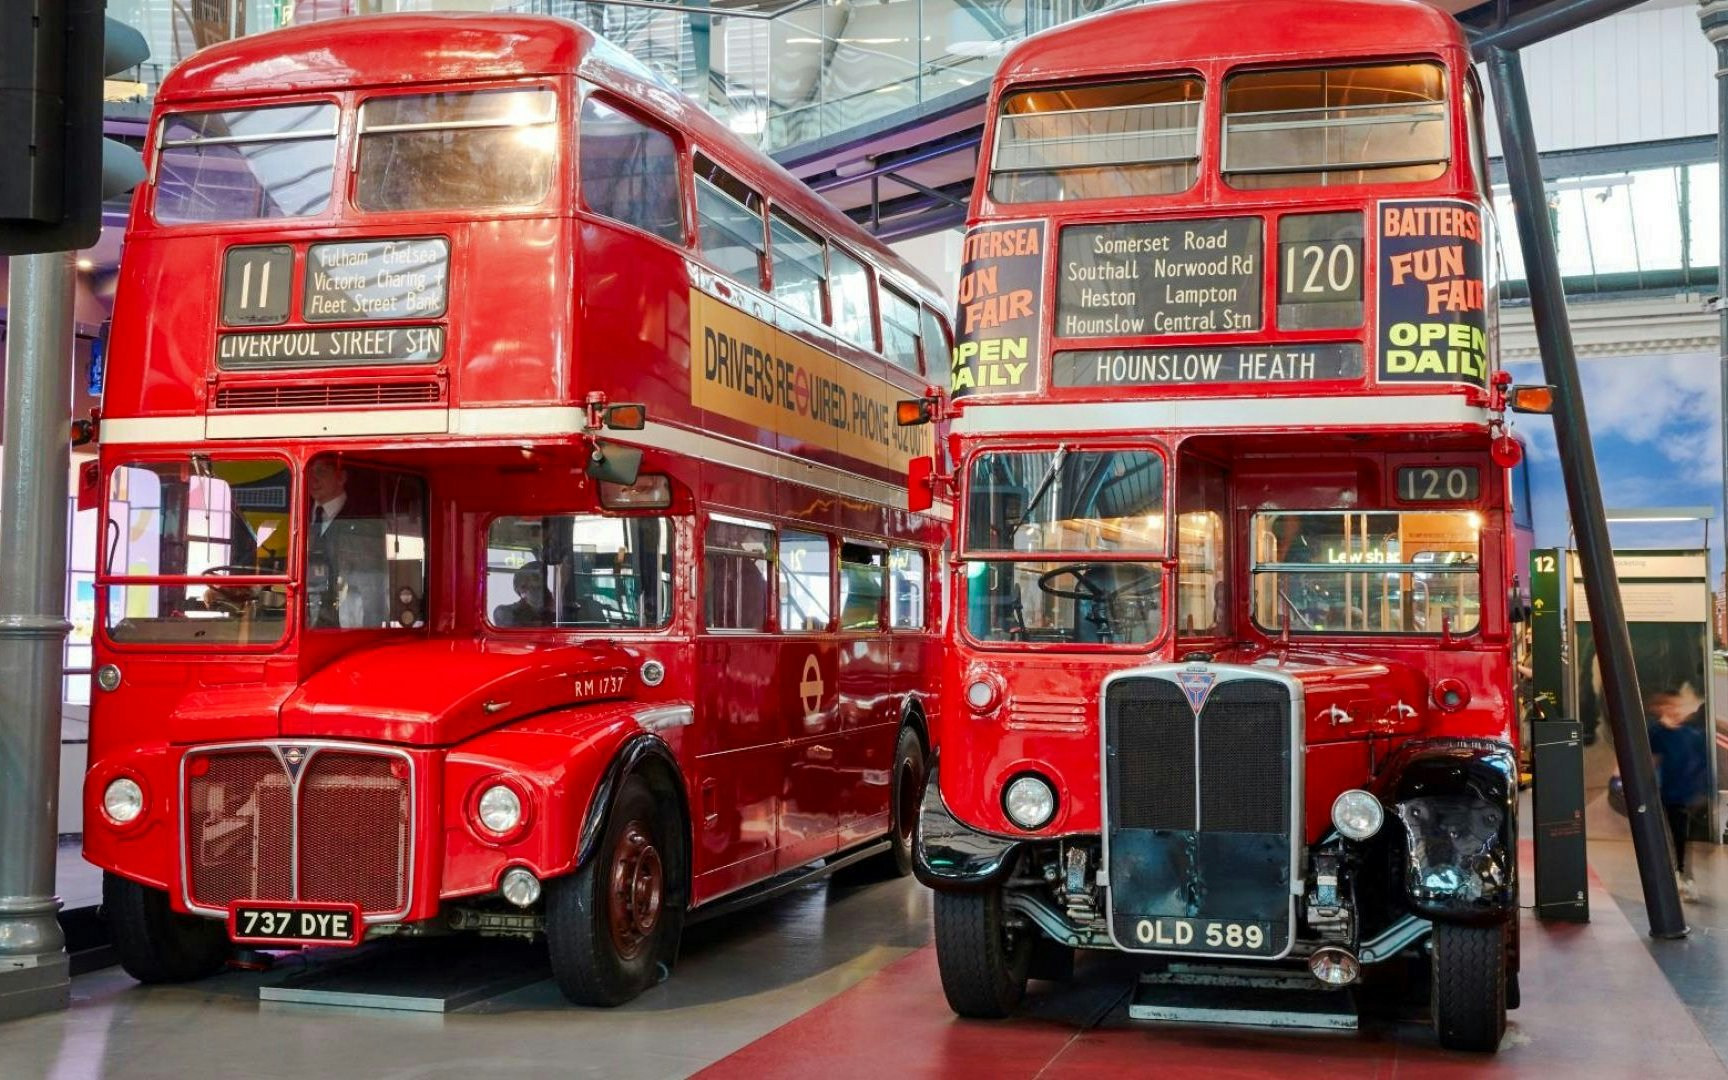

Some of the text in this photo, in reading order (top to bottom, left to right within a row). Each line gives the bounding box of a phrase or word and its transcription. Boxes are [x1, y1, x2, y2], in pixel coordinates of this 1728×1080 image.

[1384, 207, 1482, 245] BATTERS
[321, 245, 436, 267] Fulham Chelsea
[1094, 230, 1227, 254] Somerset Road
[314, 271, 366, 291] Victoria
[377, 268, 426, 290] Charing
[1068, 254, 1253, 281] Southall Norwood Rd
[1286, 243, 1354, 294] 120
[1389, 245, 1465, 286] FUN
[240, 260, 271, 309] 11
[959, 265, 999, 304] UN
[1081, 285, 1237, 307] Heston Lampton
[311, 292, 442, 314] Fleet Street Bank
[965, 289, 1035, 335] FAIR
[1066, 309, 1251, 335] Hounslow Central Stn
[221, 327, 440, 358] LIVERPOOL STREET STN
[1388, 322, 1486, 354] OPEN
[1096, 352, 1315, 382] HOUNSLOW HEATH
[1387, 349, 1487, 381] DAILY
[705, 326, 774, 404] DRIVERS
[852, 391, 889, 446] PHONE
[1408, 468, 1468, 500] 120
[1534, 556, 1555, 573] 12
[575, 676, 624, 697] RM 1737
[244, 912, 348, 937] 737 DYE
[1136, 920, 1263, 948] OLD 589
